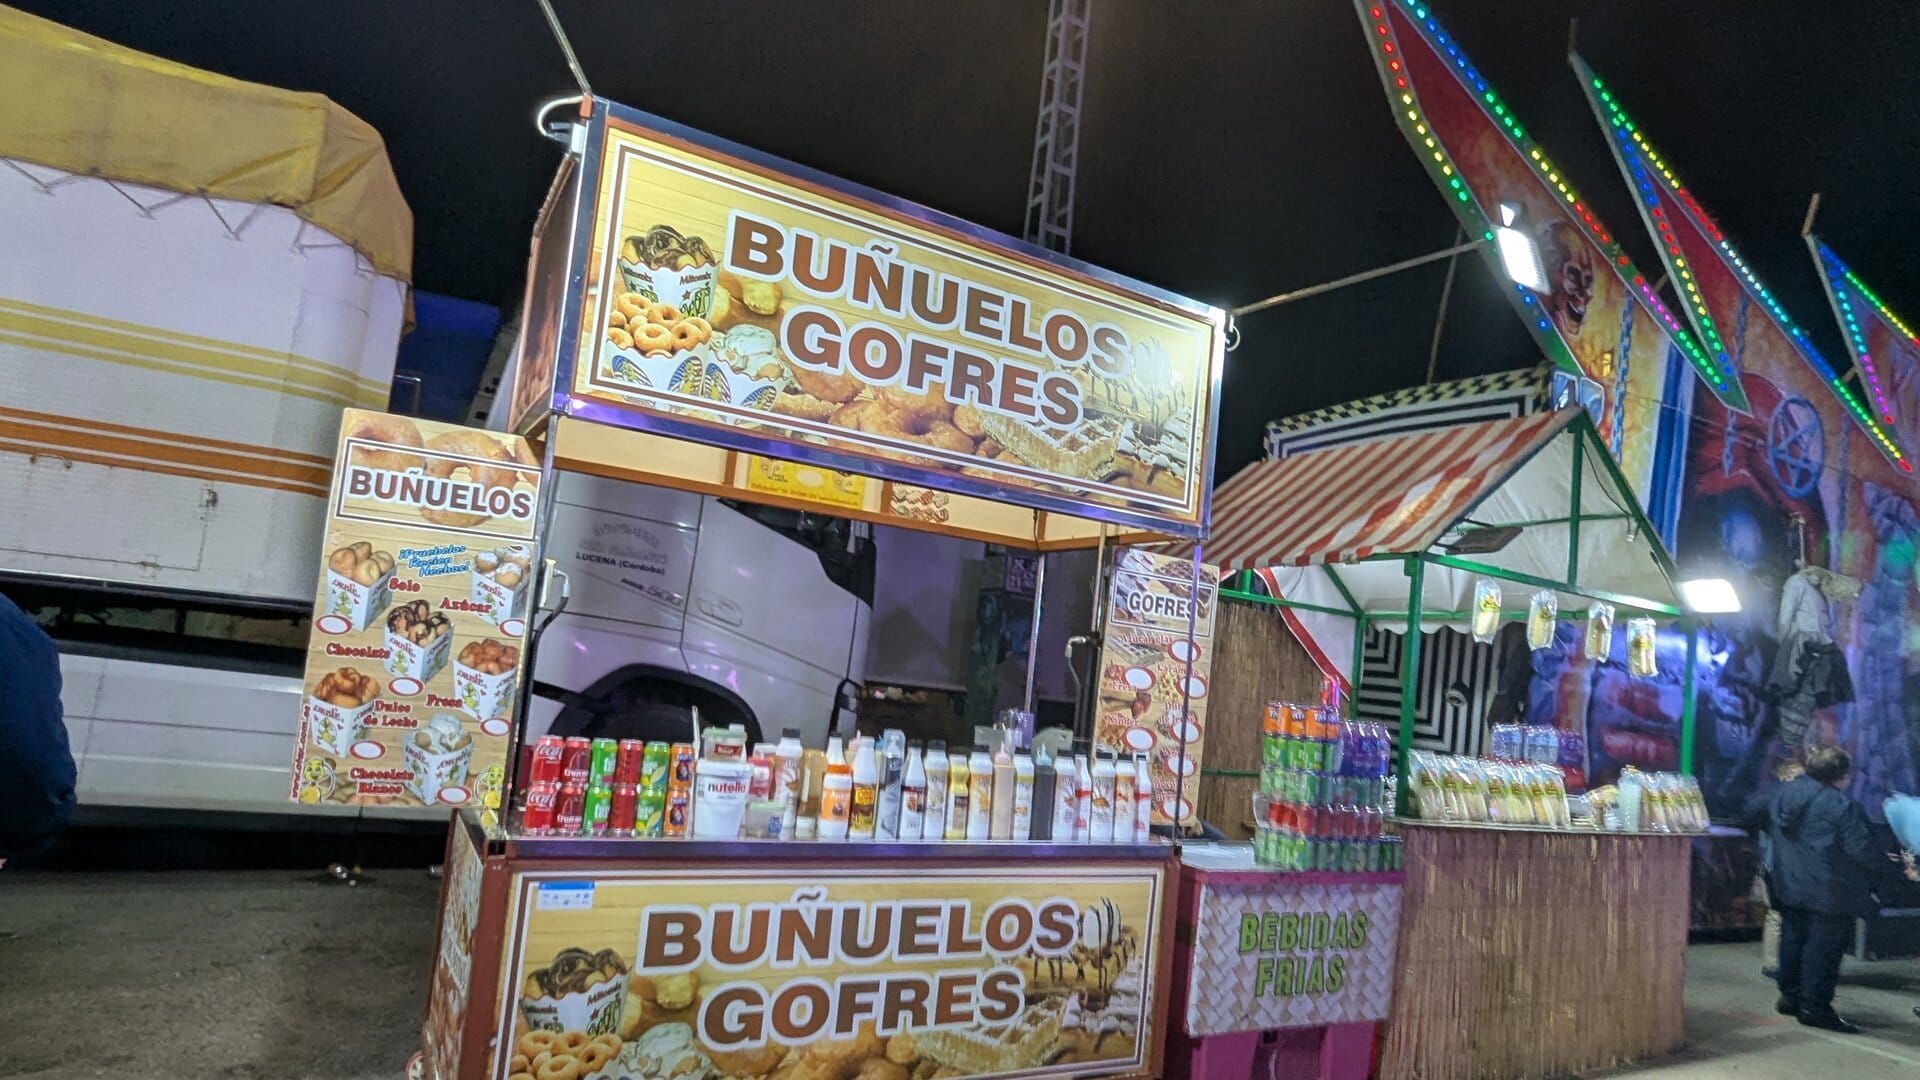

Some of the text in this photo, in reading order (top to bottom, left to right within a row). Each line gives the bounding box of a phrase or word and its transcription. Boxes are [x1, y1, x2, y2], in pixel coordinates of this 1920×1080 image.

[729, 213, 1130, 375] BUÑUELOS
[785, 311, 1083, 427] GOFRES
[349, 468, 531, 519] BUÑUELOS
[326, 642, 391, 659] Chocolate
[374, 700, 411, 713] Dulce
[642, 889, 1077, 969] BUÑUELOS
[1239, 911, 1369, 953] BEBIDAS
[1255, 955, 1346, 998] FRIAS
[703, 969, 1025, 1044] GOFRES
